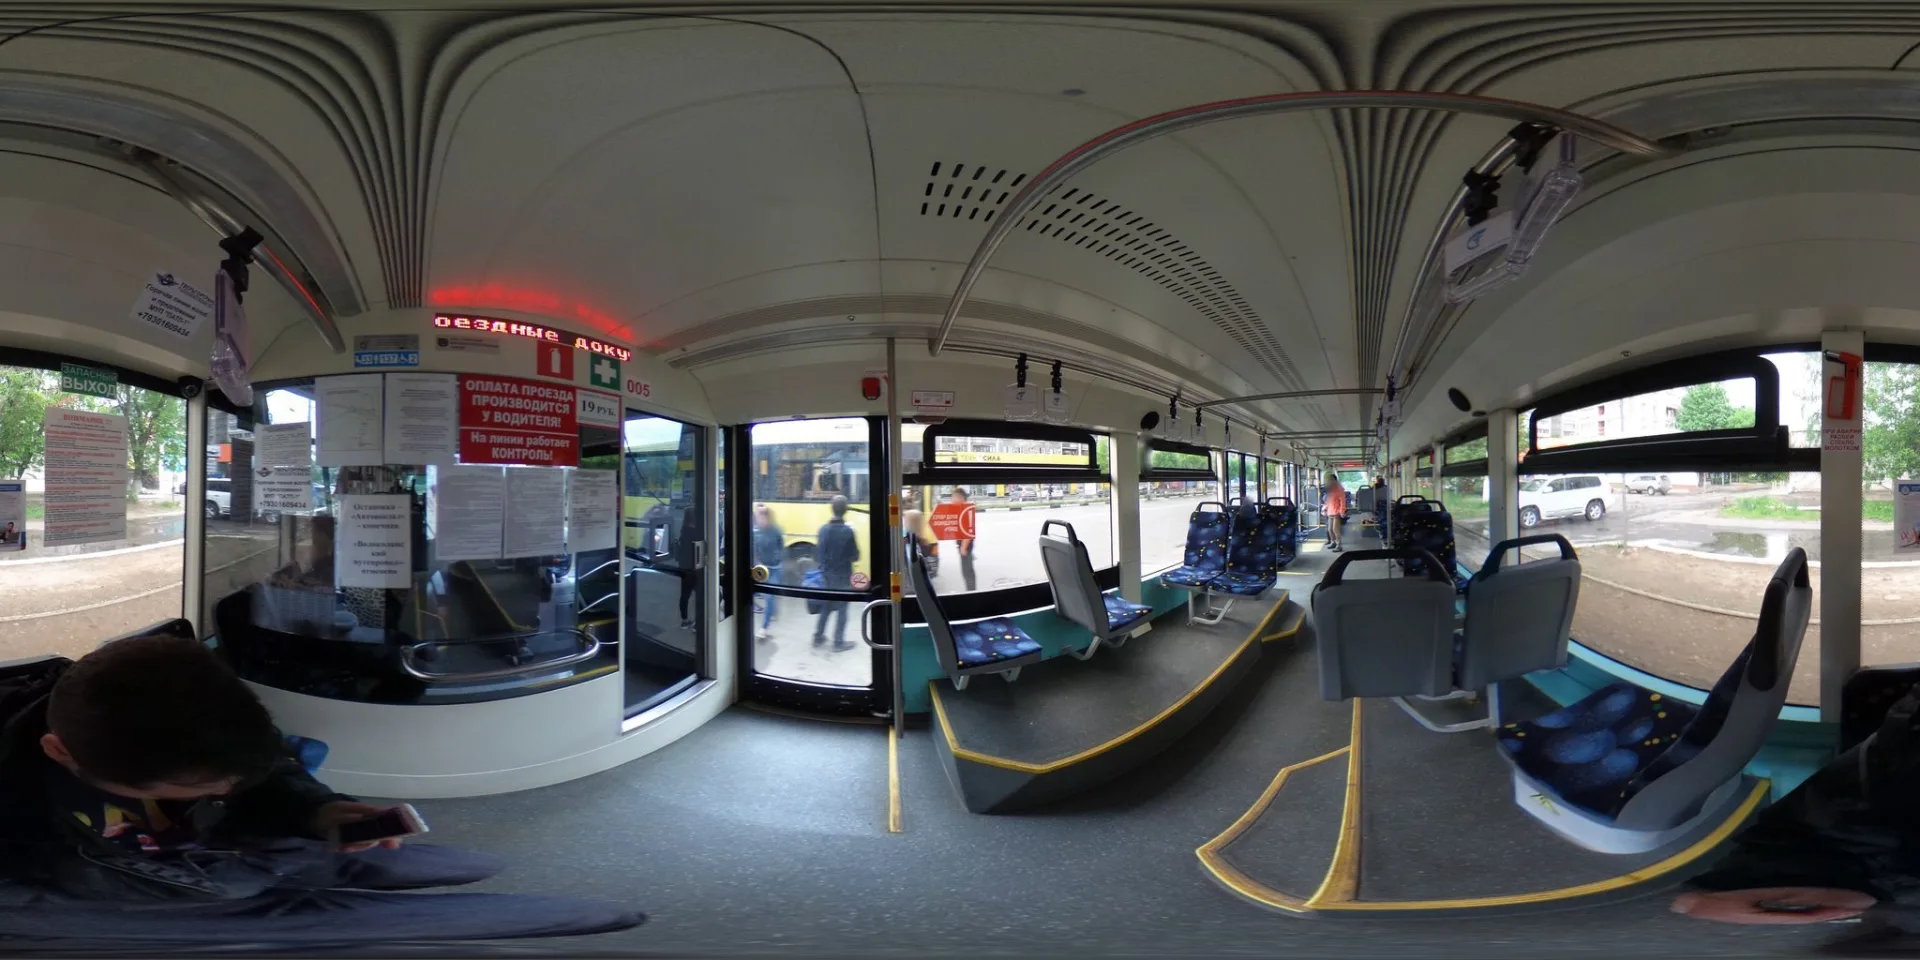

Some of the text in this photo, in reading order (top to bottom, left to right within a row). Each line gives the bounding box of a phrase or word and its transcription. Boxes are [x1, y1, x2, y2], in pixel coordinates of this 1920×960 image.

[435, 316, 559, 342] оездные
[574, 337, 631, 361] доку
[63, 365, 118, 381] ЗАПАСНЫЙ
[63, 376, 117, 397] ВЫХОД
[465, 380, 519, 394] ОПЛАТА
[521, 385, 574, 402] ПРОЕЗДА
[627, 379, 650, 397] 005
[472, 394, 570, 414] ПРОИЗВОДИТСЯ
[582, 400, 595, 412] 19
[482, 410, 561, 428] У ВОДИТЕЛЯ!
[471, 431, 570, 448] На линии работает
[492, 447, 553, 461] КОНТРОЛЬ!
